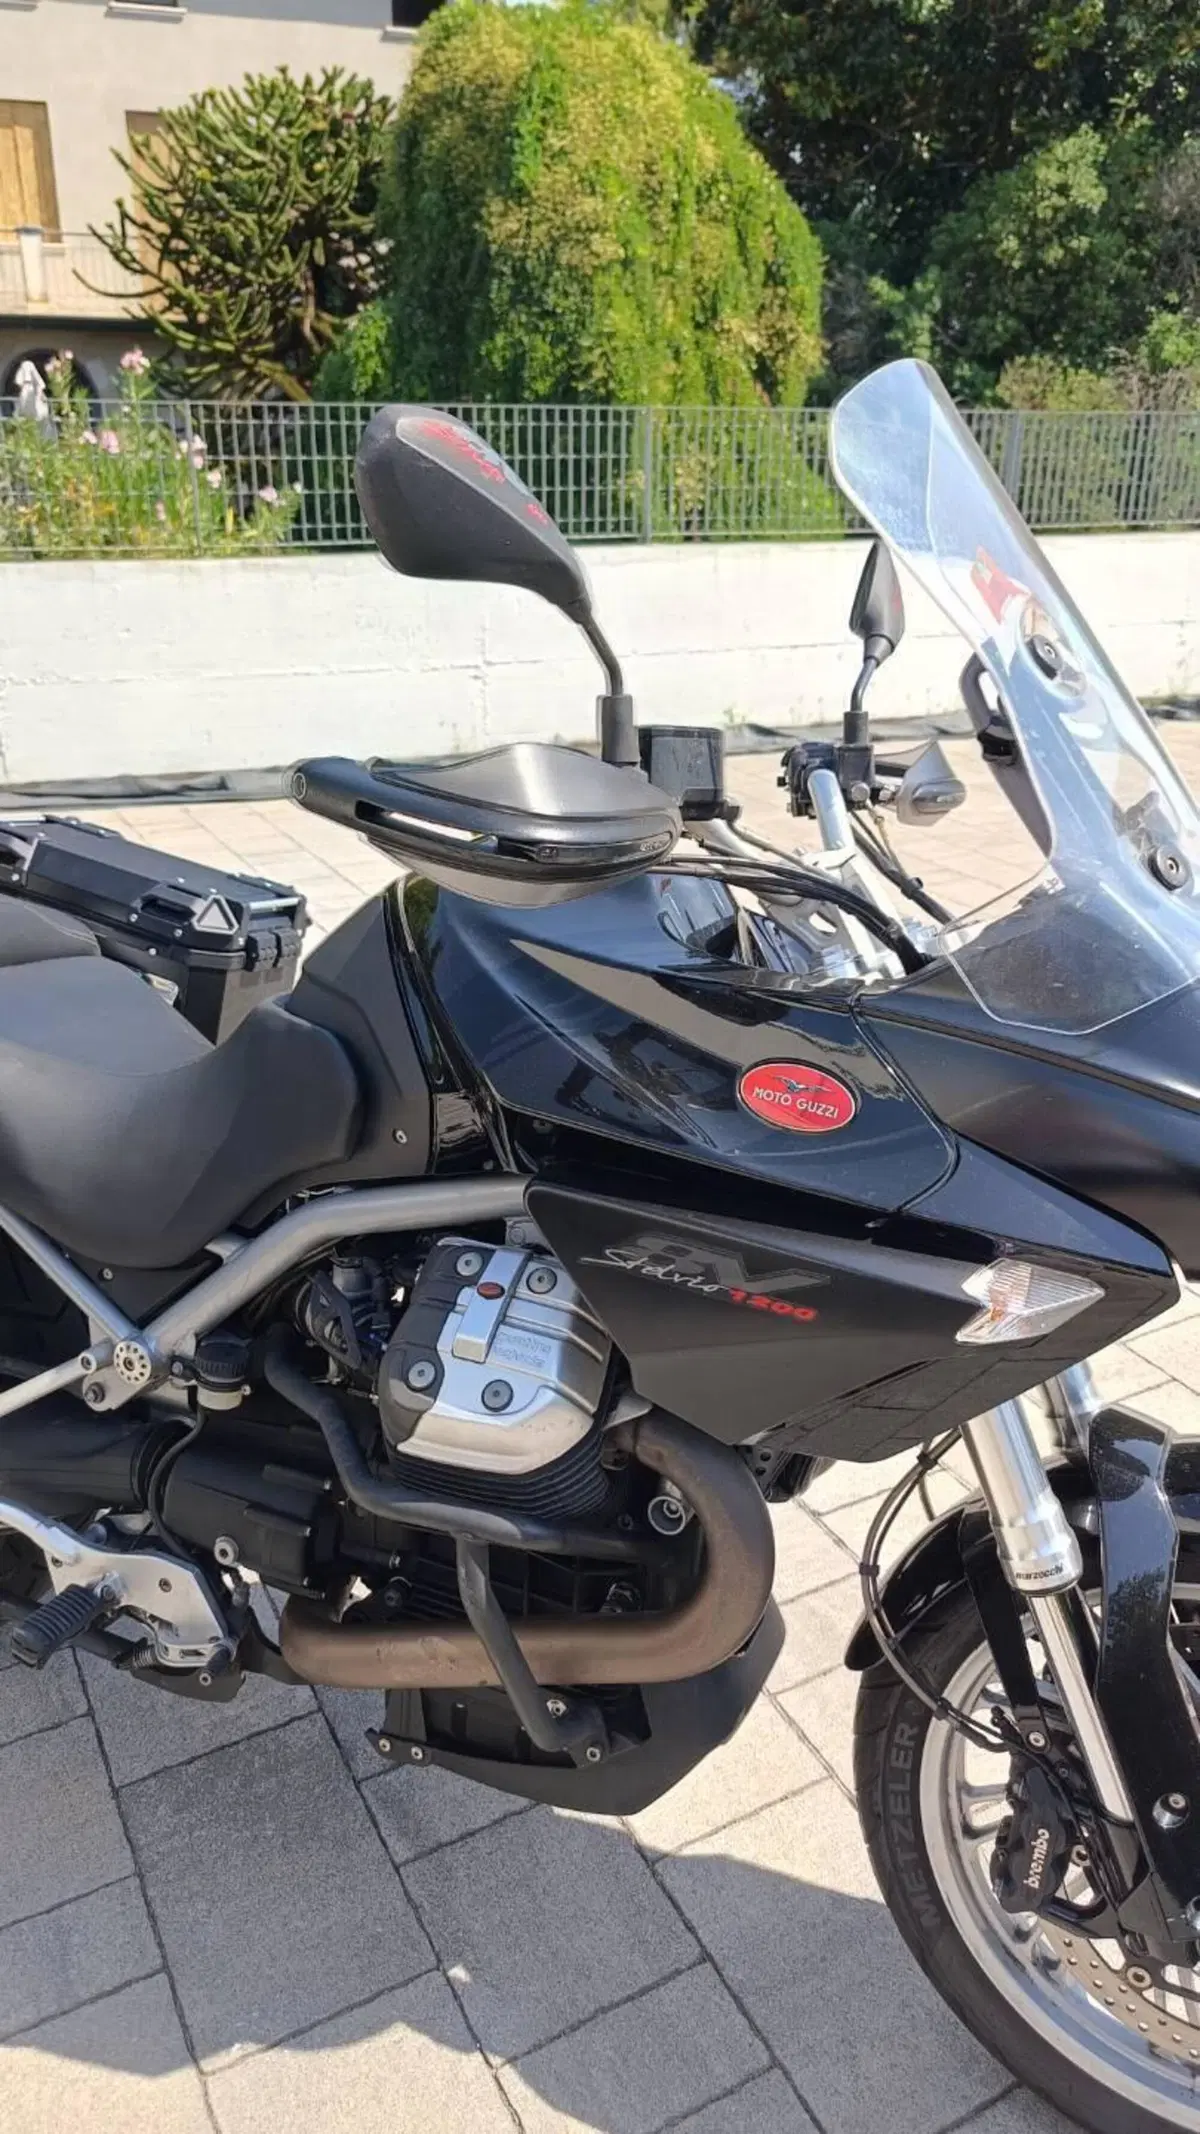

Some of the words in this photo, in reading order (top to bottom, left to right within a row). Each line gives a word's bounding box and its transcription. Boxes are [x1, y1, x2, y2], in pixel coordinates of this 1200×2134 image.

[752, 1086, 792, 1106] MOTO
[796, 1099, 839, 1119] GUZZI
[579, 1248, 730, 1295] Stelvio
[729, 1287, 818, 1321] 1200
[1016, 1563, 1064, 1580] marzocchi
[889, 1722, 941, 1928] METZELER
[1023, 1828, 1050, 1889] brembo
